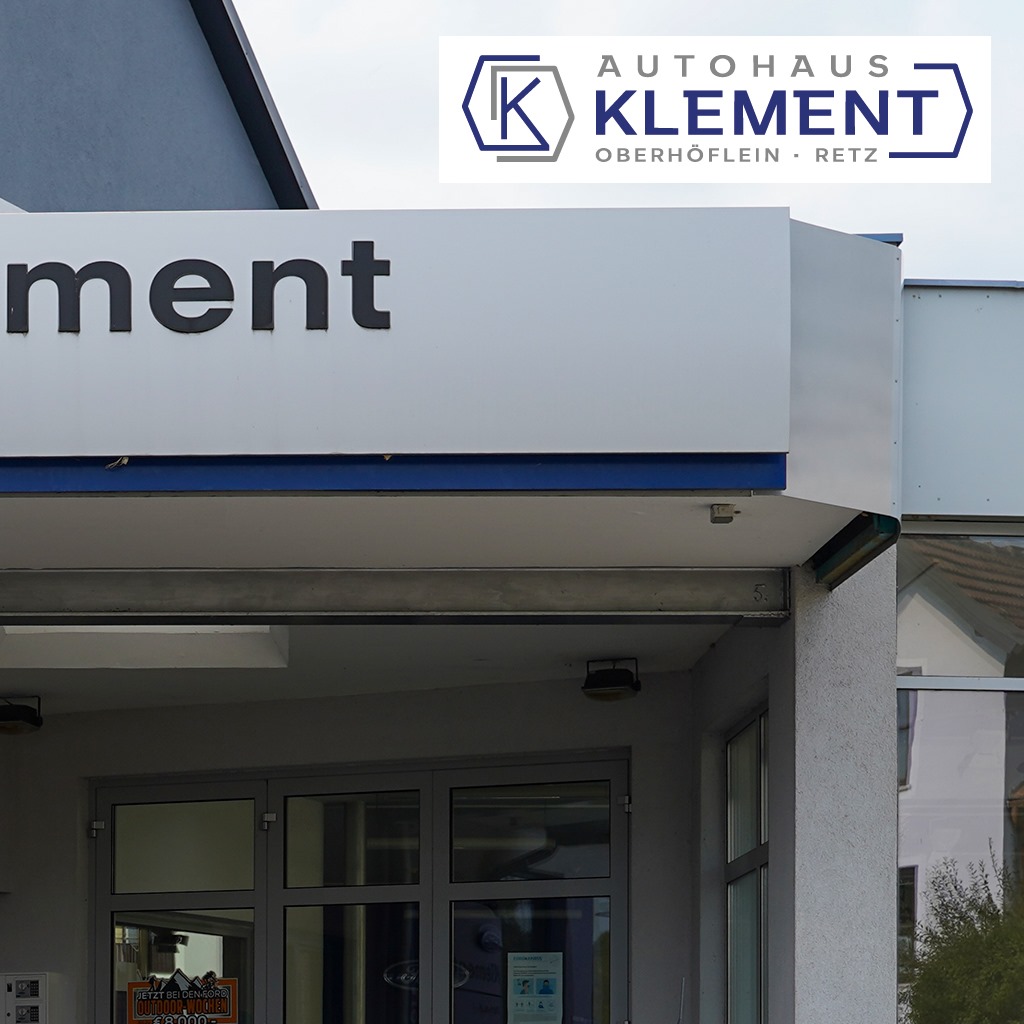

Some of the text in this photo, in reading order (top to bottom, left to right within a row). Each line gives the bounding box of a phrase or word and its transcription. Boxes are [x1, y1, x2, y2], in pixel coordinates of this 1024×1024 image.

[138, 989, 229, 1000] JETZT BEI DEN FORD
